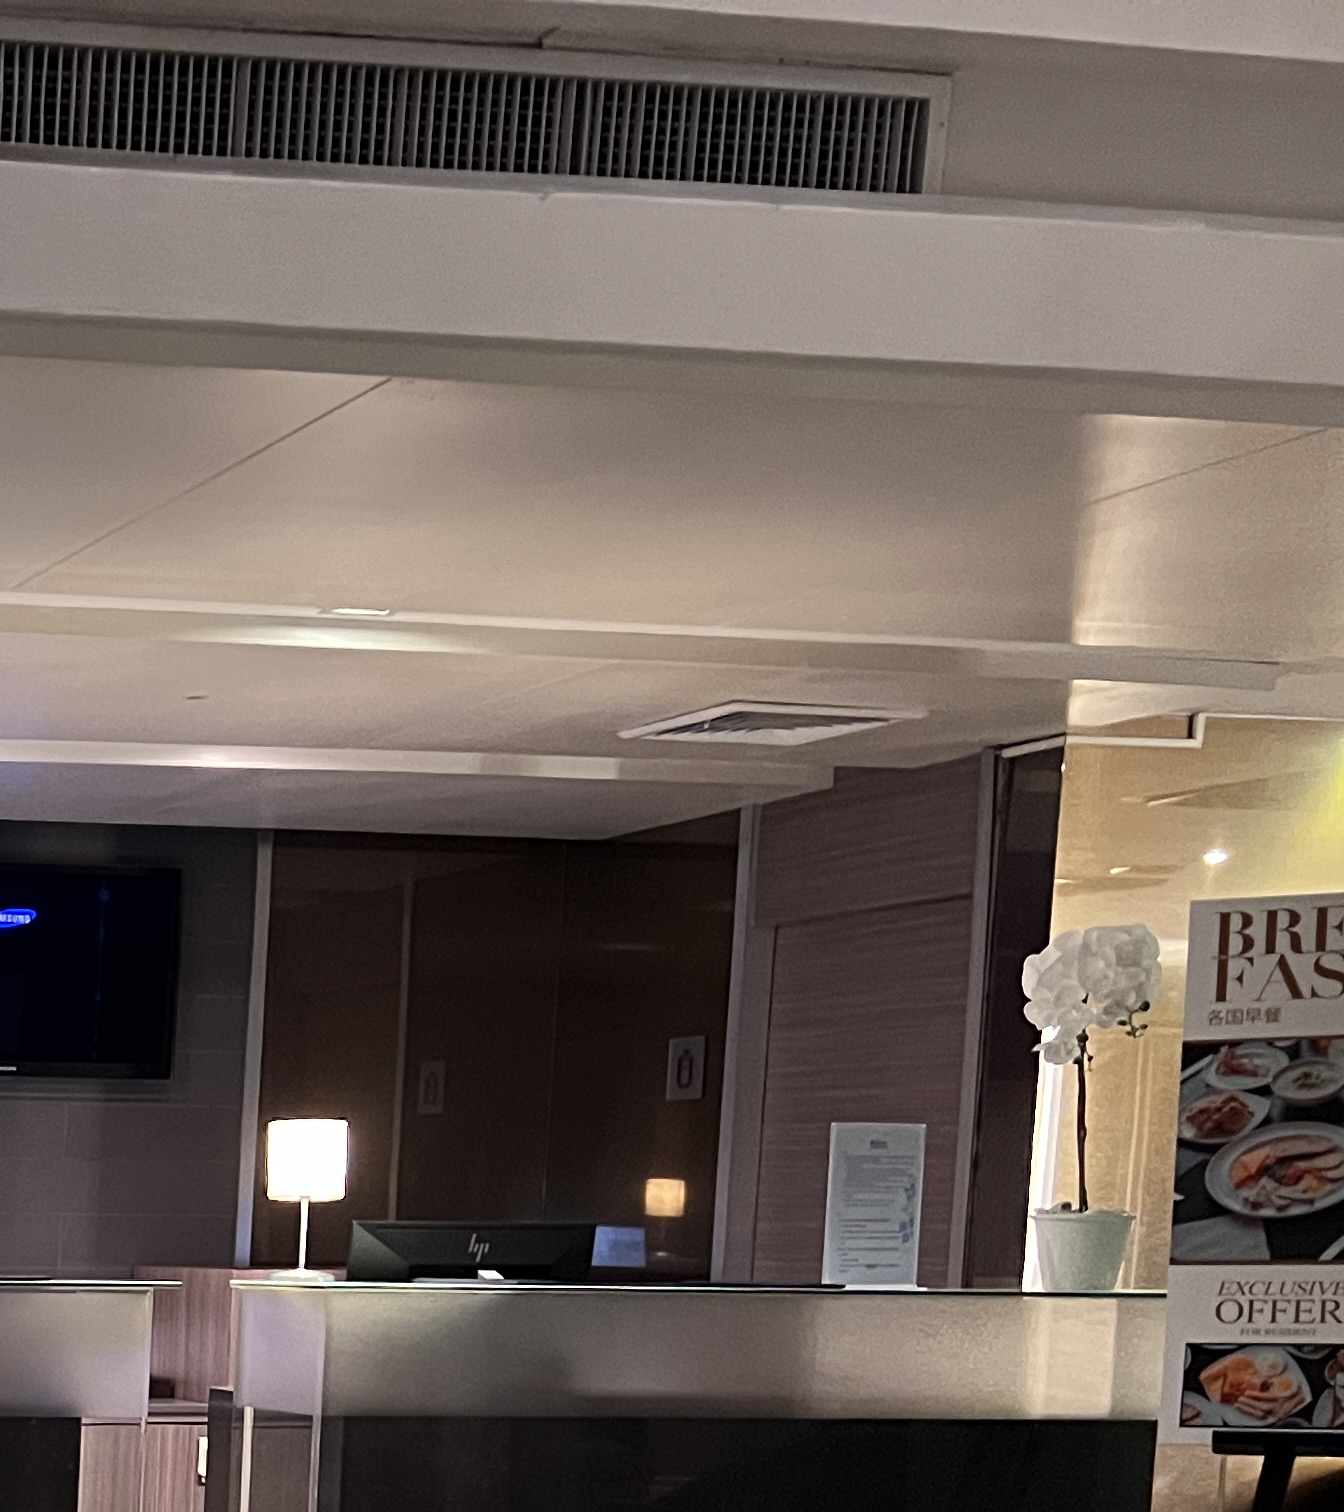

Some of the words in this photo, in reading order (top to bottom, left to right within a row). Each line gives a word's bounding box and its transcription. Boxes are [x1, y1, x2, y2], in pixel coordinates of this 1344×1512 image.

[1215, 905, 1344, 957] BRE
[1212, 952, 1344, 1003] FAS
[1208, 1007, 1282, 1026] 各国早餐
[1218, 1280, 1344, 1296] EXCLUSIVE
[1215, 1298, 1344, 1324] OFFER
